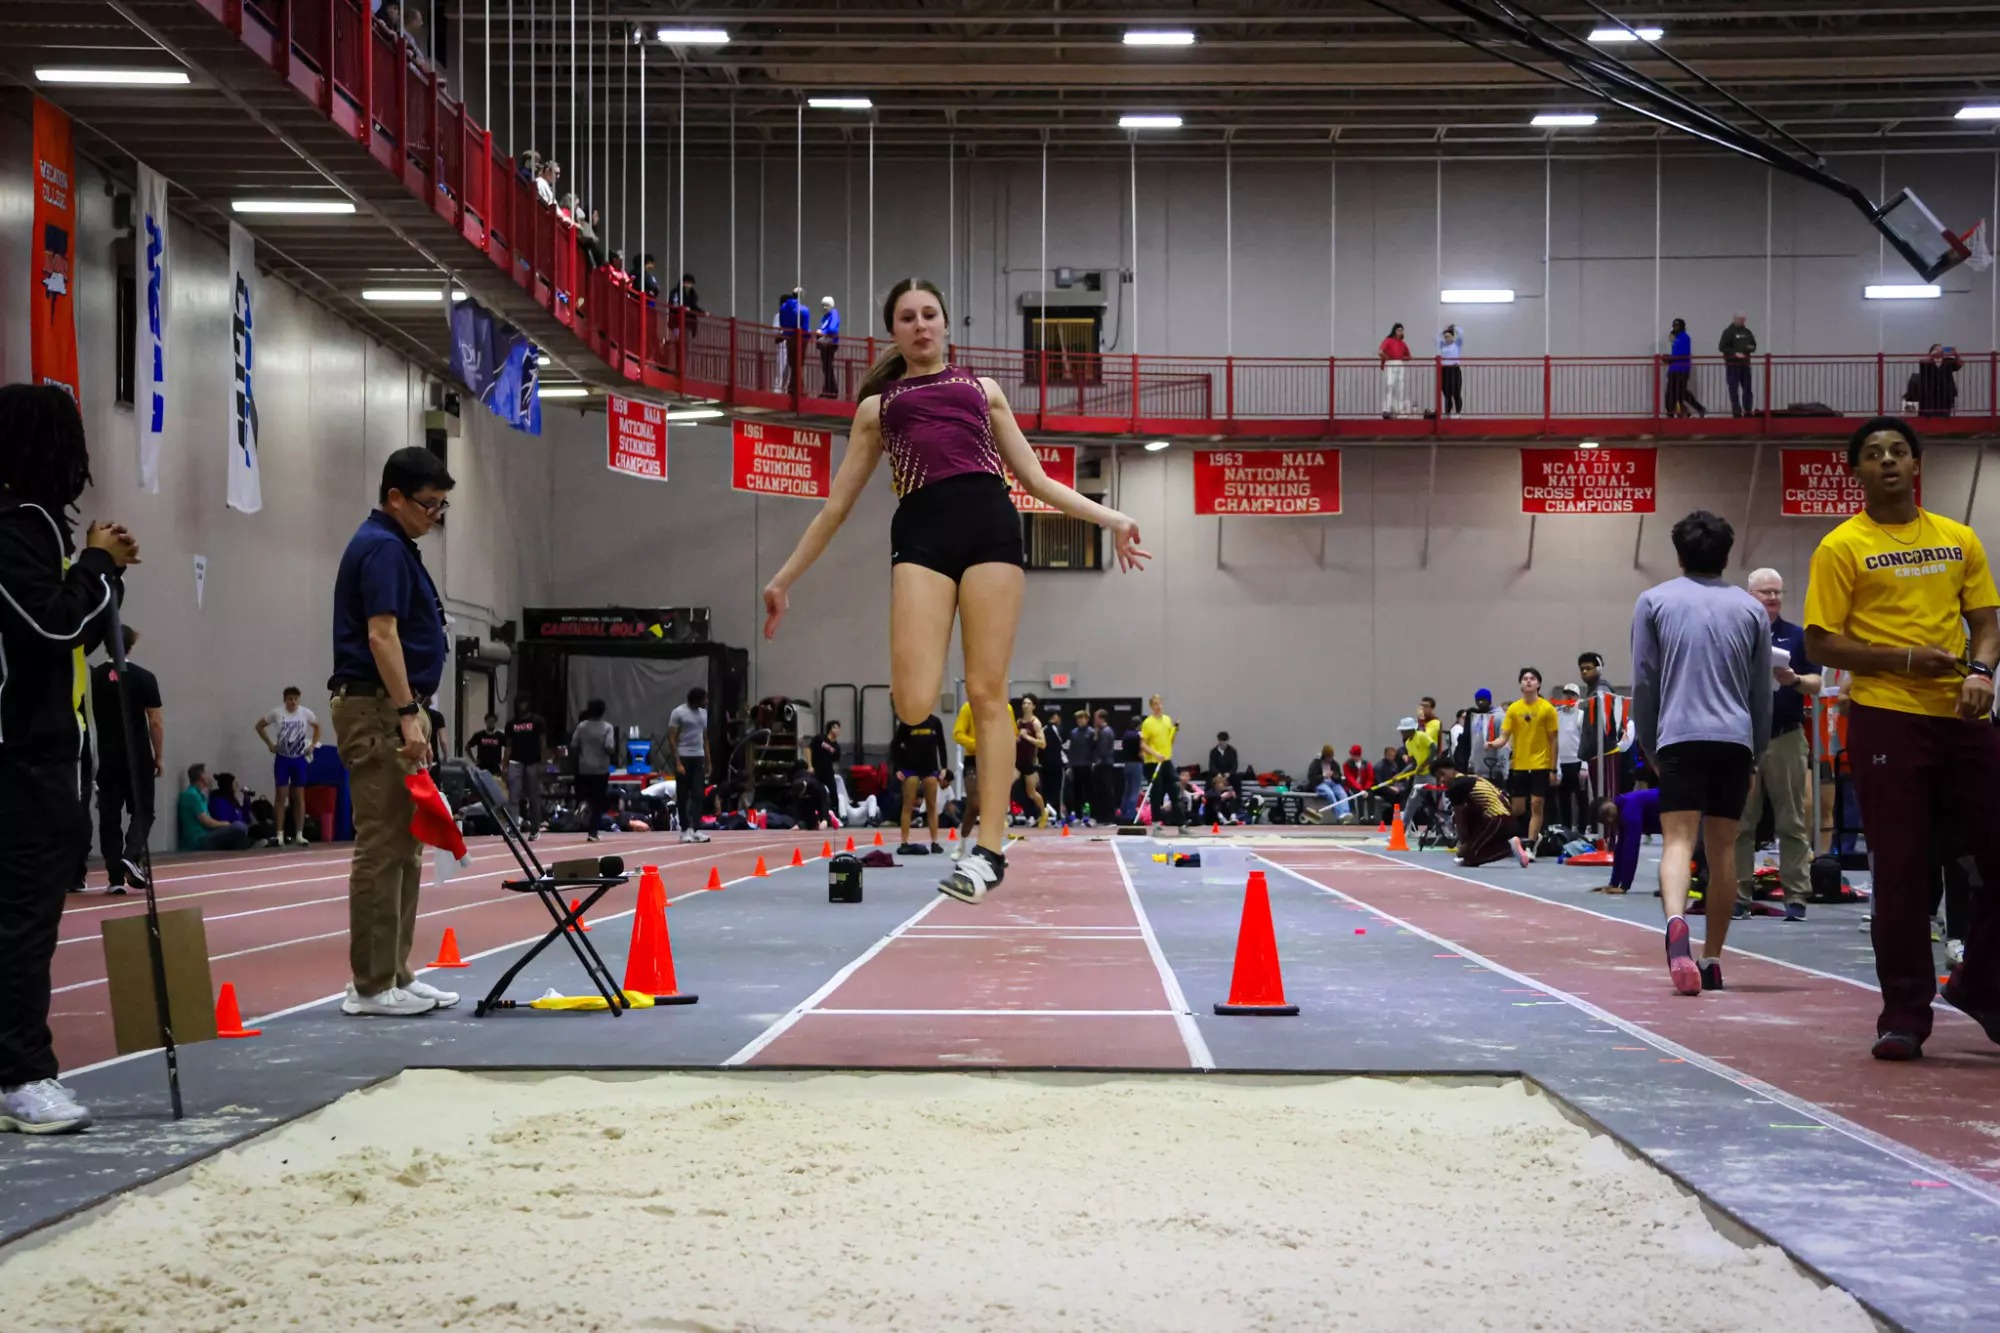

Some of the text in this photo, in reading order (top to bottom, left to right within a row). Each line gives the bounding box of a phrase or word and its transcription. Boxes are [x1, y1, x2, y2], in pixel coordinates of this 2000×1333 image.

[619, 416, 655, 440] NATIONAL
[744, 423, 821, 447] 1961 NAIA
[754, 441, 812, 462] NATIONAL
[1034, 448, 1060, 462] AIA
[1574, 450, 1610, 461] 1975
[615, 452, 660, 475] CHAMPIONS
[1209, 452, 1325, 466] 1963 NAIA
[753, 458, 812, 478] SWIMMING
[1224, 468, 1310, 481] NATIONAL
[1542, 462, 1587, 474] NCAA
[1626, 462, 1635, 474] 3
[1800, 464, 1845, 475] NCAA
[746, 473, 818, 495] CHAMPIONS
[1548, 475, 1630, 487] NATIONAL
[1808, 476, 1864, 488] NATIO
[1224, 483, 1311, 496] SWIMMING
[1523, 486, 1652, 499] CROSS COUNTRY
[1786, 489, 1838, 501] CROSS
[1214, 498, 1321, 512] CHAMPIONS
[1545, 500, 1633, 512] CHAMPIONS
[1864, 546, 1964, 570] CONCORDIA
